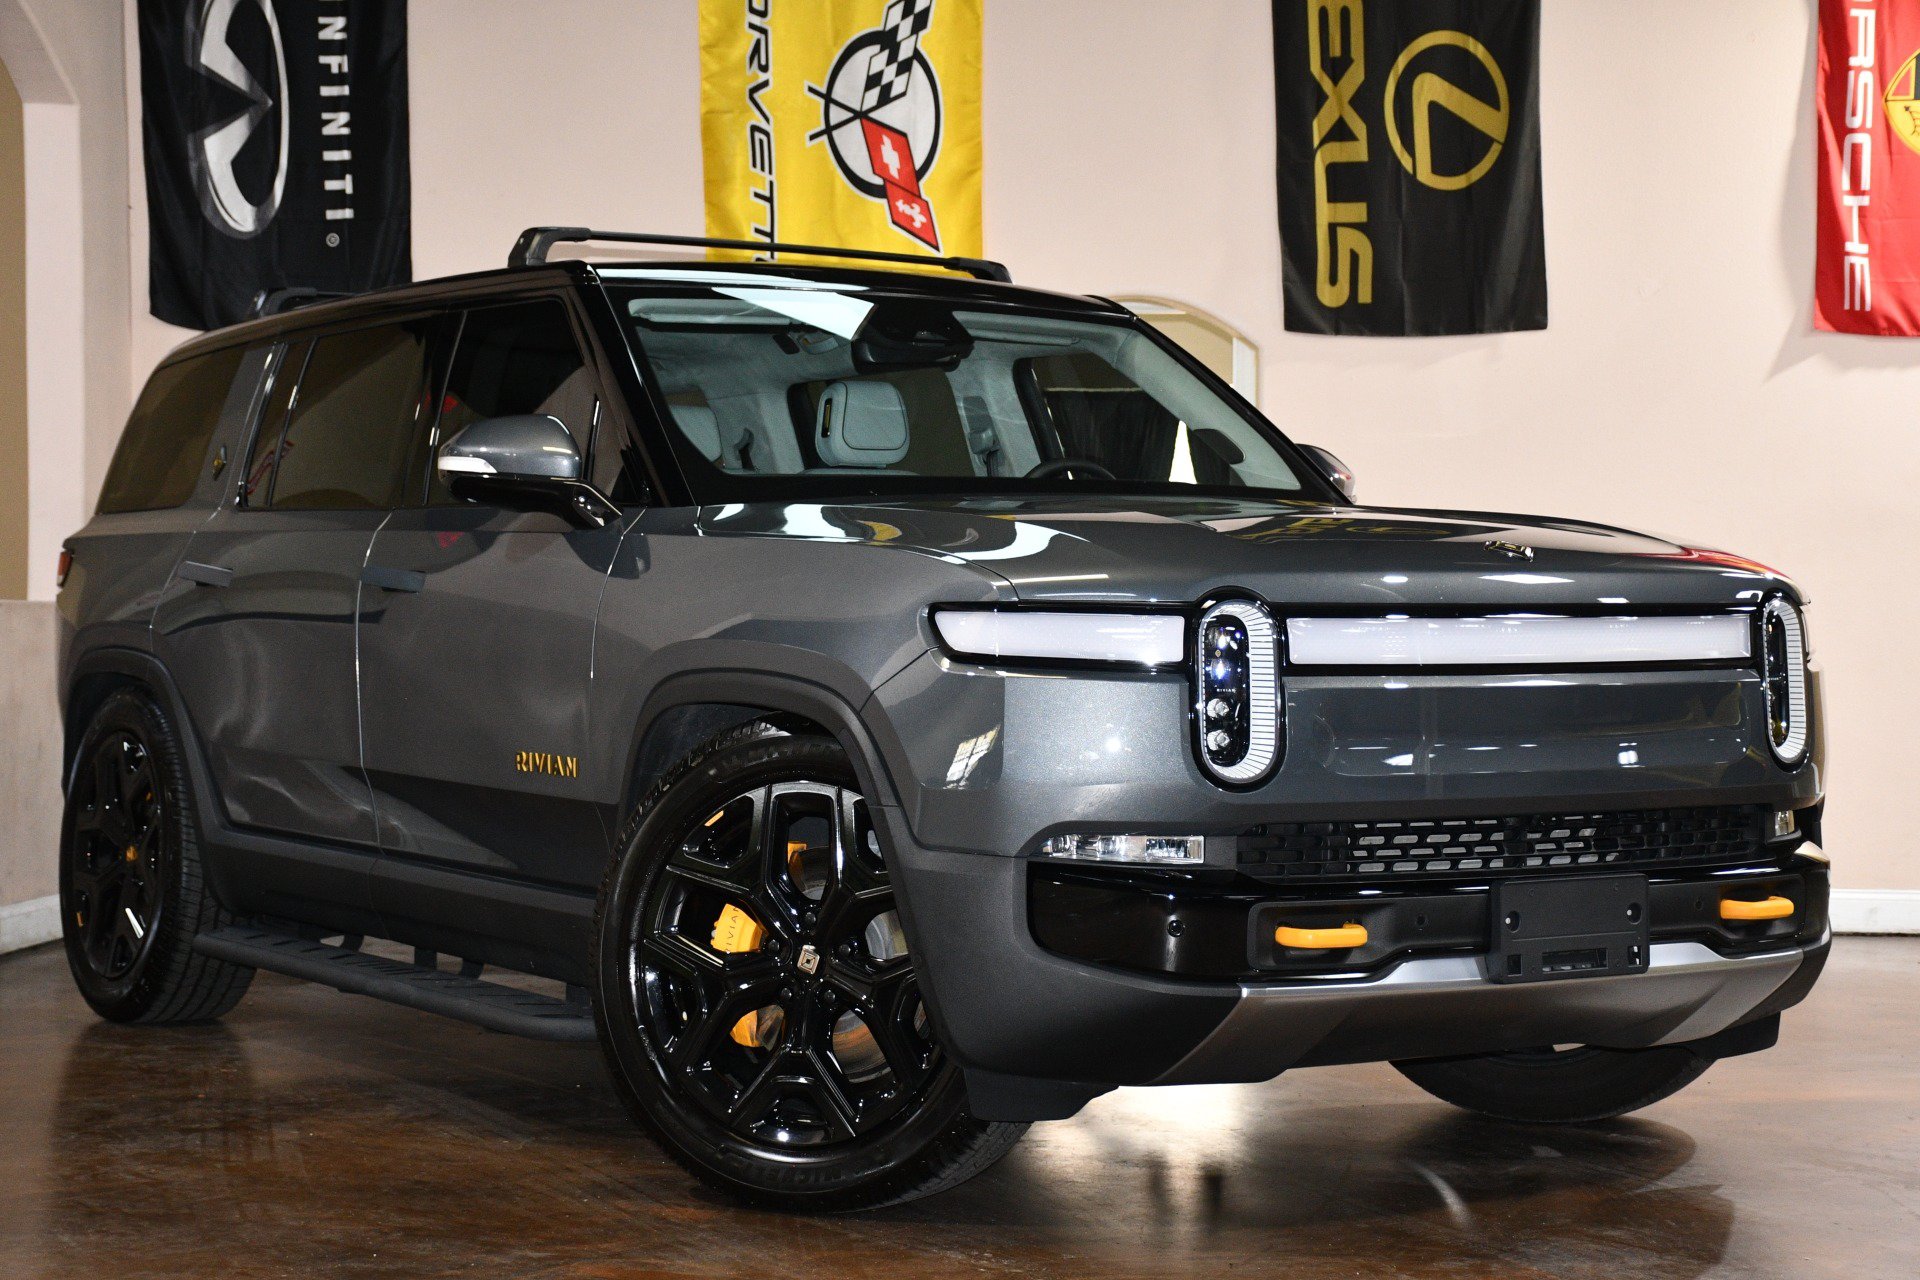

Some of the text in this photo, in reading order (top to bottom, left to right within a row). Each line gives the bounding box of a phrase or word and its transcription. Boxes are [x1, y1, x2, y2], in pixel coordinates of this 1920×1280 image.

[747, 0, 777, 262] RVETT
[1841, 0, 1877, 312] RSCHE
[516, 751, 578, 778] RIVIAN
